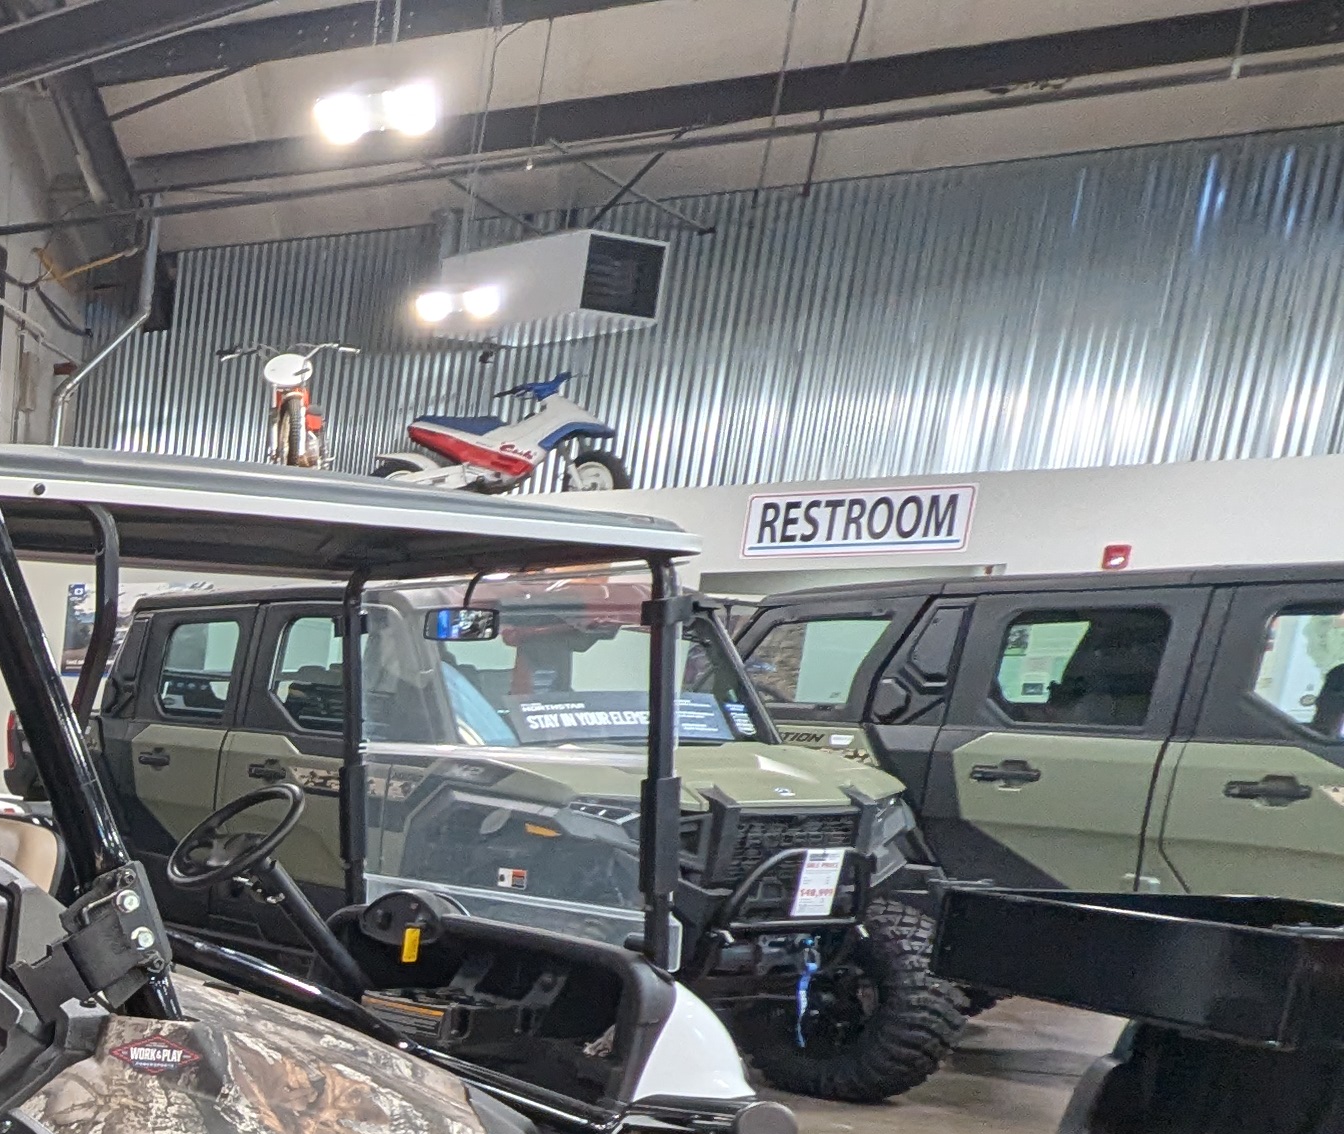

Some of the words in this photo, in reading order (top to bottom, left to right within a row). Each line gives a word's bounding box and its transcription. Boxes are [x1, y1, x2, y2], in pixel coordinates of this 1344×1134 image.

[757, 494, 959, 543] RESTROOM
[526, 714, 562, 730] STAY
[561, 713, 578, 728] IN
[577, 712, 611, 727] YOUR
[611, 710, 650, 726] ELEME
[780, 732, 825, 742] TION
